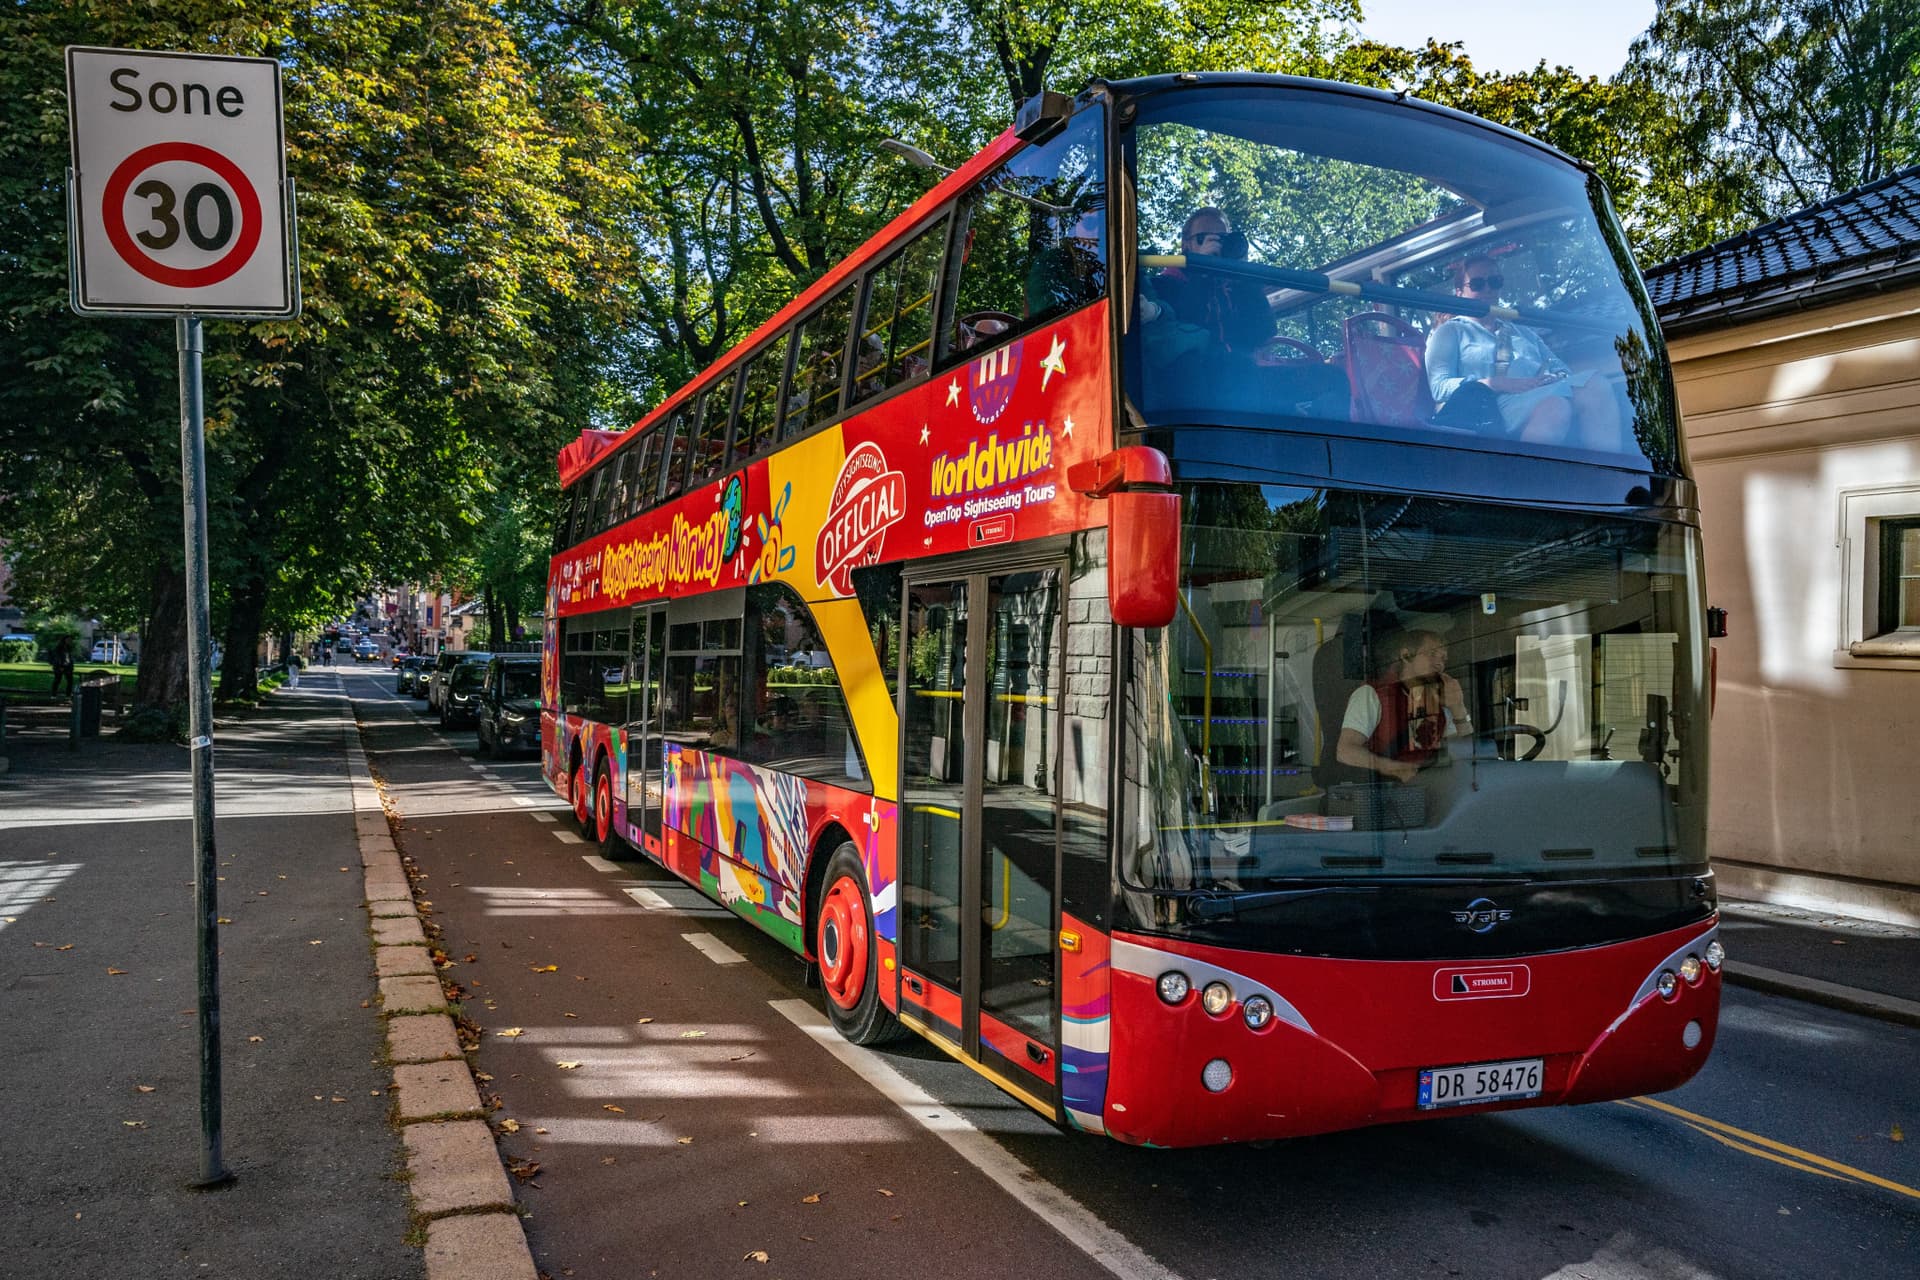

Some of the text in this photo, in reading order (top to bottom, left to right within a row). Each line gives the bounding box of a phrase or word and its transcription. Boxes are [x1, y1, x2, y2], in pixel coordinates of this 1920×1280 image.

[109, 68, 245, 118] Sone
[133, 180, 234, 251] 30
[972, 395, 1009, 425] Operator
[835, 453, 882, 506] CITYSIGHTSEEING
[931, 424, 1052, 497] Worldwide
[823, 479, 900, 570] OFFICIAL
[924, 484, 1056, 528] OpenTop Sightseeing Tours
[668, 511, 728, 587] Norway
[1472, 977, 1508, 987] STROMMA
[1422, 1091, 1429, 1100] N
[1437, 1066, 1538, 1099] DR 58476
